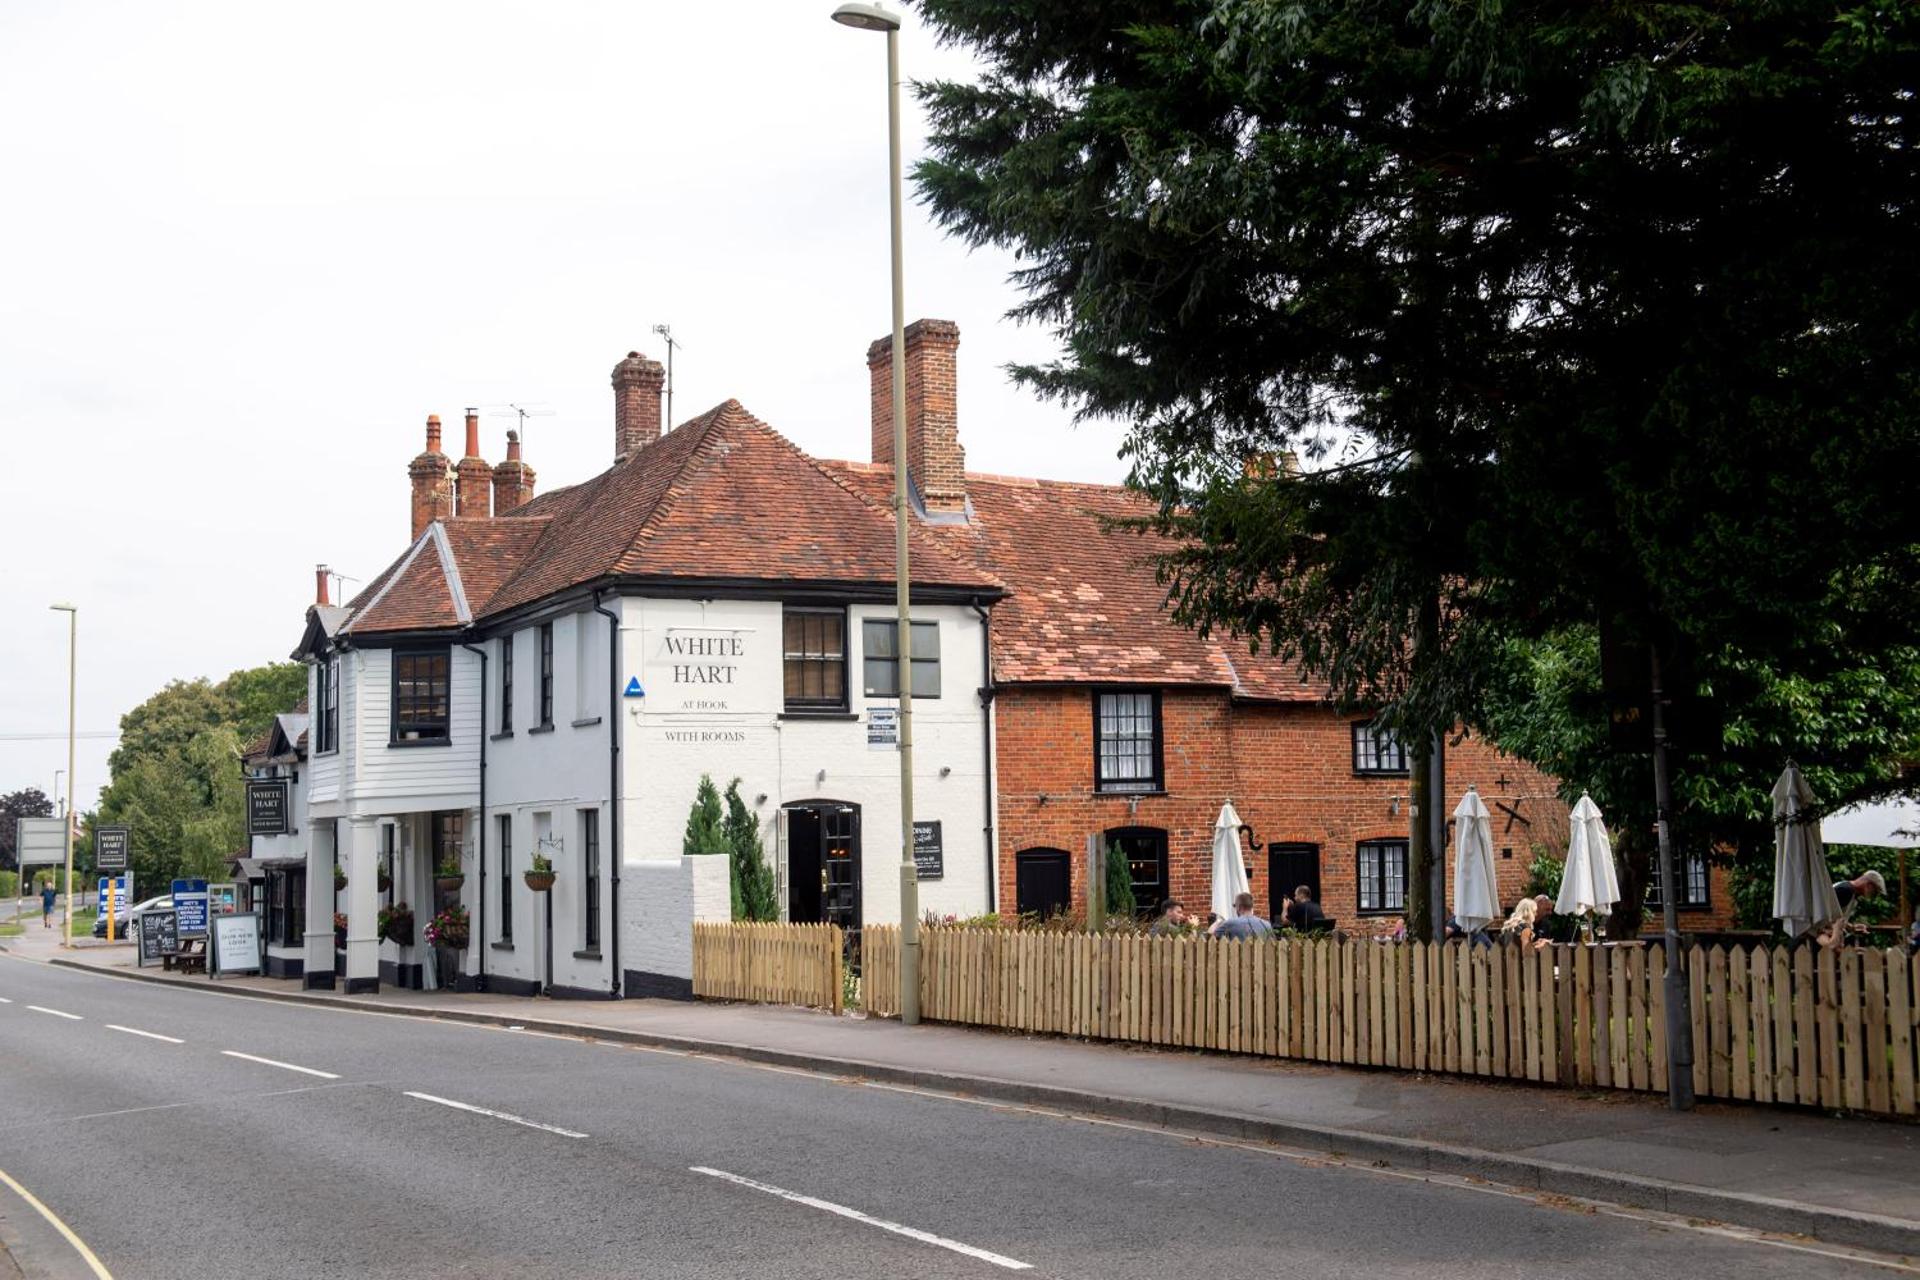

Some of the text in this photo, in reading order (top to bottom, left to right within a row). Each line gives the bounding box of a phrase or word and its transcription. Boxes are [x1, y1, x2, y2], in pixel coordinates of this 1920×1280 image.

[665, 637, 744, 656] WHITE
[673, 665, 737, 683] HART
[681, 700, 728, 710] AT HOOK
[665, 731, 745, 742] WITH ROOMS
[252, 791, 281, 799] WHITE
[255, 800, 279, 808] HART
